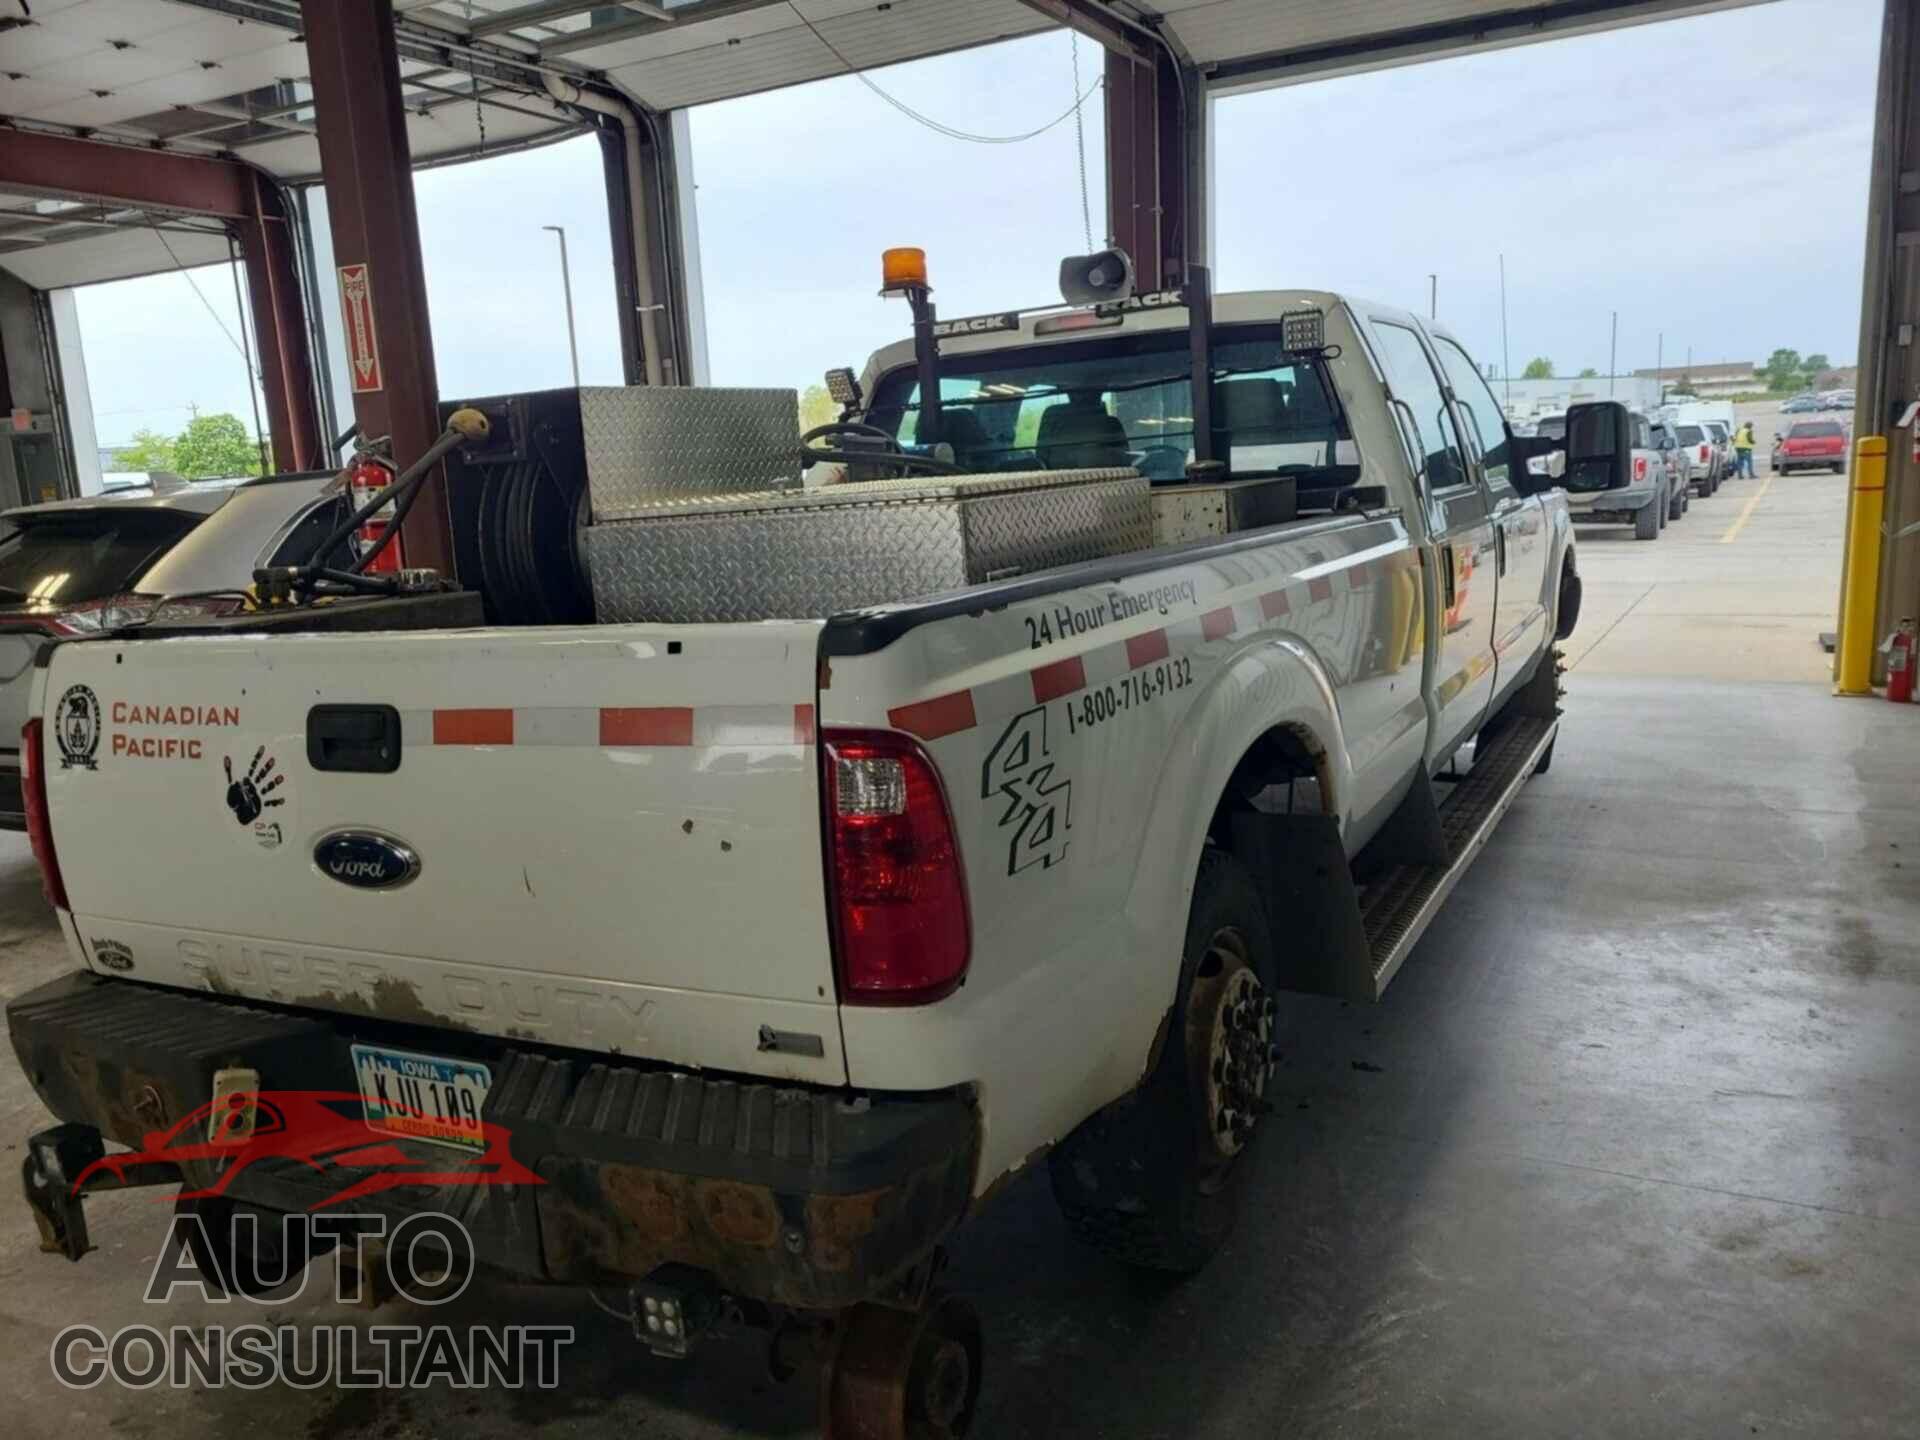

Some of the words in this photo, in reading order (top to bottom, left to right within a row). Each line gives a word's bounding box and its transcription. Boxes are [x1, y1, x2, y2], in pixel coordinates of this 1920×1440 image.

[1025, 611, 1052, 650] 24
[1055, 602, 1106, 640] Hour
[1107, 579, 1198, 622] Emergency
[111, 701, 241, 727] CANADIAN
[1066, 657, 1194, 735] 1-800-716-9132
[111, 733, 203, 760] PACIFIC
[441, 972, 657, 1043] DUTY
[400, 1059, 441, 1080] IOWA
[373, 1072, 423, 1119] KJU
[429, 1082, 478, 1130] 109
